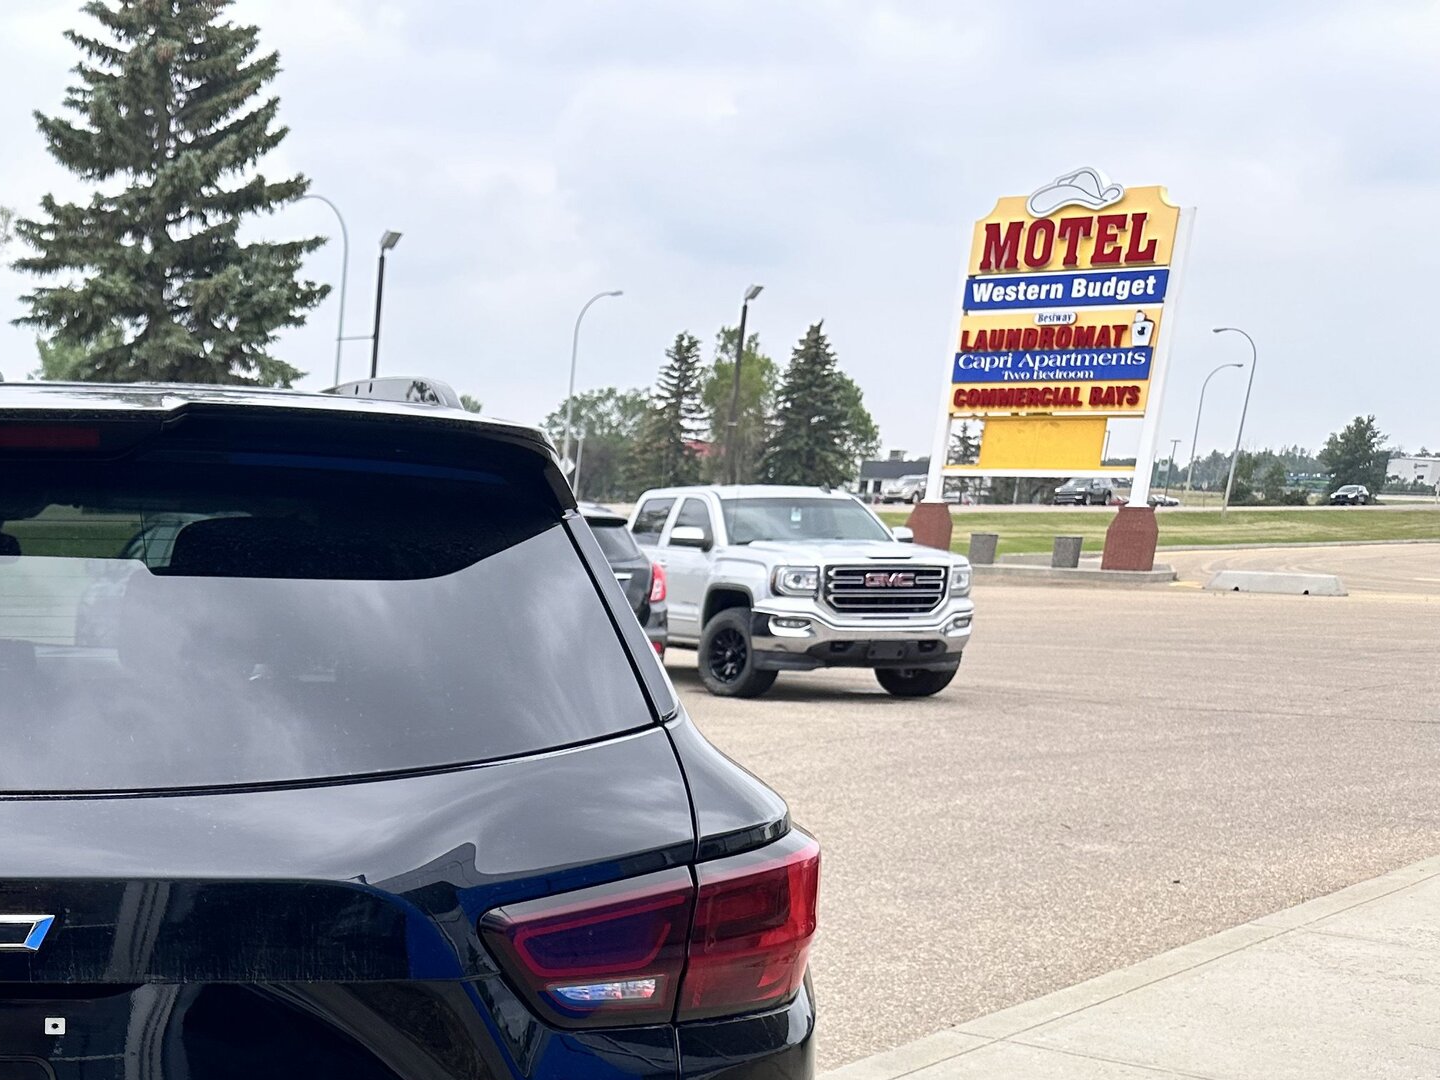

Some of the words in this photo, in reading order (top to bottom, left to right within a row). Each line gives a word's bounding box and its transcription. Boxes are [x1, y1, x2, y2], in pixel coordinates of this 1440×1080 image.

[979, 212, 1158, 272] MOTEL
[972, 280, 1063, 303] Western
[1071, 274, 1156, 300] Budget
[1037, 313, 1073, 323] Bestway
[960, 325, 1129, 352] LAUNDROMAT
[958, 353, 1012, 371] Capri
[1018, 350, 1146, 370] Apartments
[1002, 370, 1030, 380] Two
[1033, 369, 1094, 380] Bedroom
[953, 386, 1083, 408] COMMERCIAL
[1089, 385, 1141, 407] BAYS
[865, 572, 915, 587] GMC
